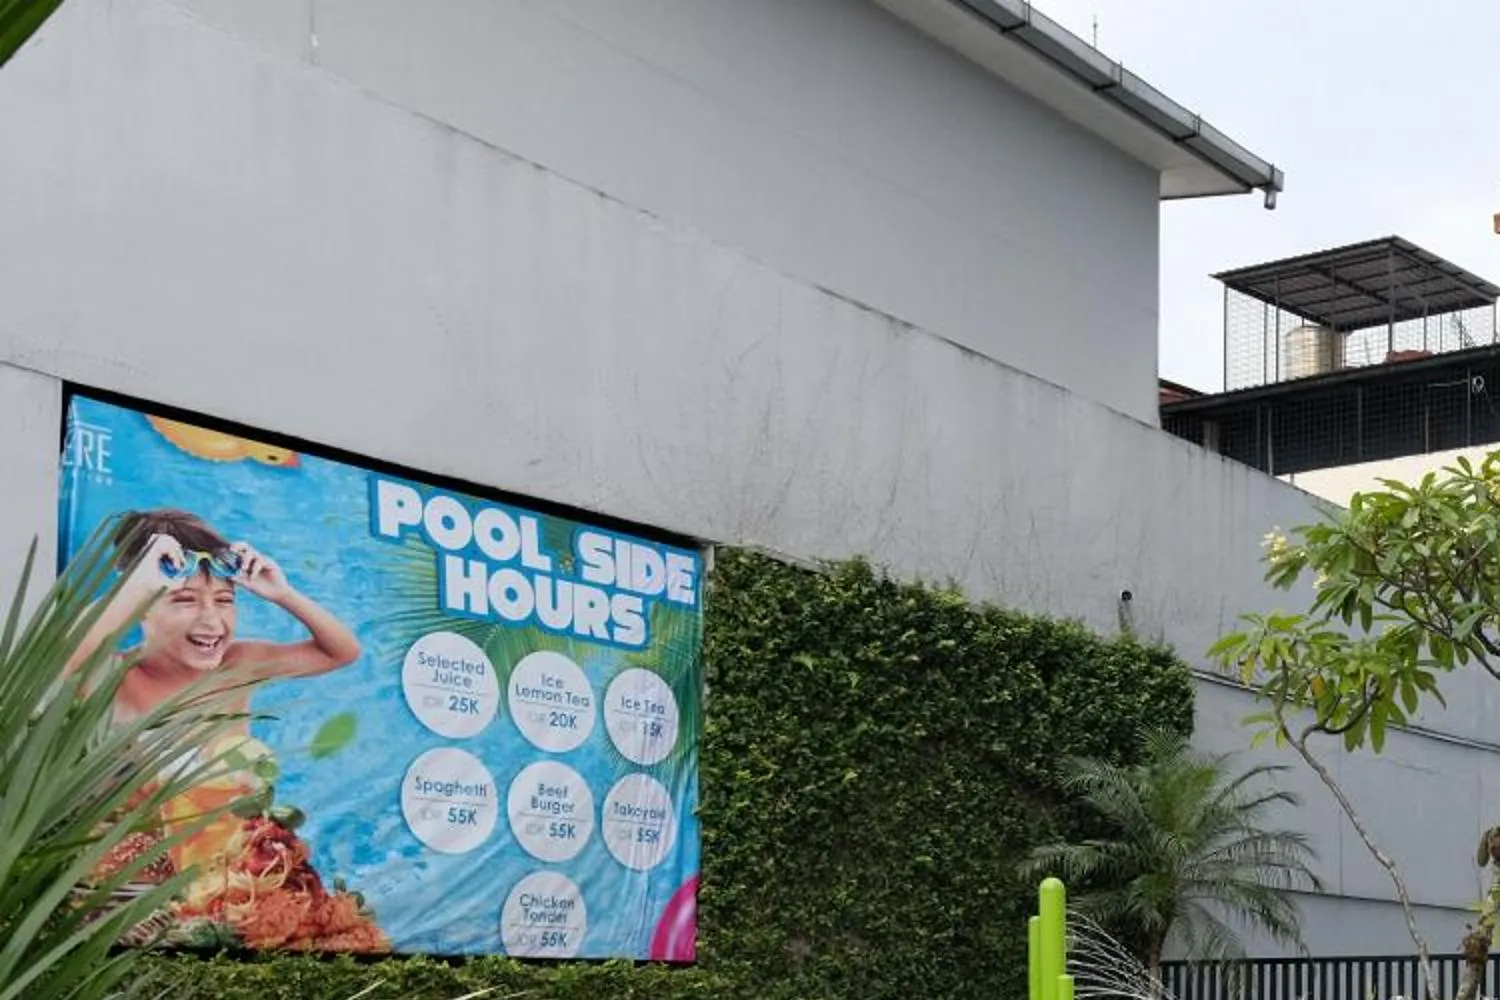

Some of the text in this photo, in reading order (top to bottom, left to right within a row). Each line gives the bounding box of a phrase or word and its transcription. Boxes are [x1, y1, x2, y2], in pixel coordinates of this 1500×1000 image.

[377, 479, 696, 605] POOL SIDE
[445, 555, 647, 646] HOURS
[416, 651, 485, 676] Selected
[431, 669, 473, 689] Juice
[541, 673, 565, 688] Ice
[448, 695, 480, 714] 25K
[515, 684, 590, 708] Lemon Tea
[621, 696, 665, 715] Ice Tea
[550, 711, 578, 729] 20K
[415, 776, 488, 798] Spaghetti
[537, 783, 569, 799] Beef
[530, 796, 576, 815] Burger
[447, 807, 478, 827] 55K
[549, 822, 576, 840] 55K
[519, 893, 575, 909] Chicken
